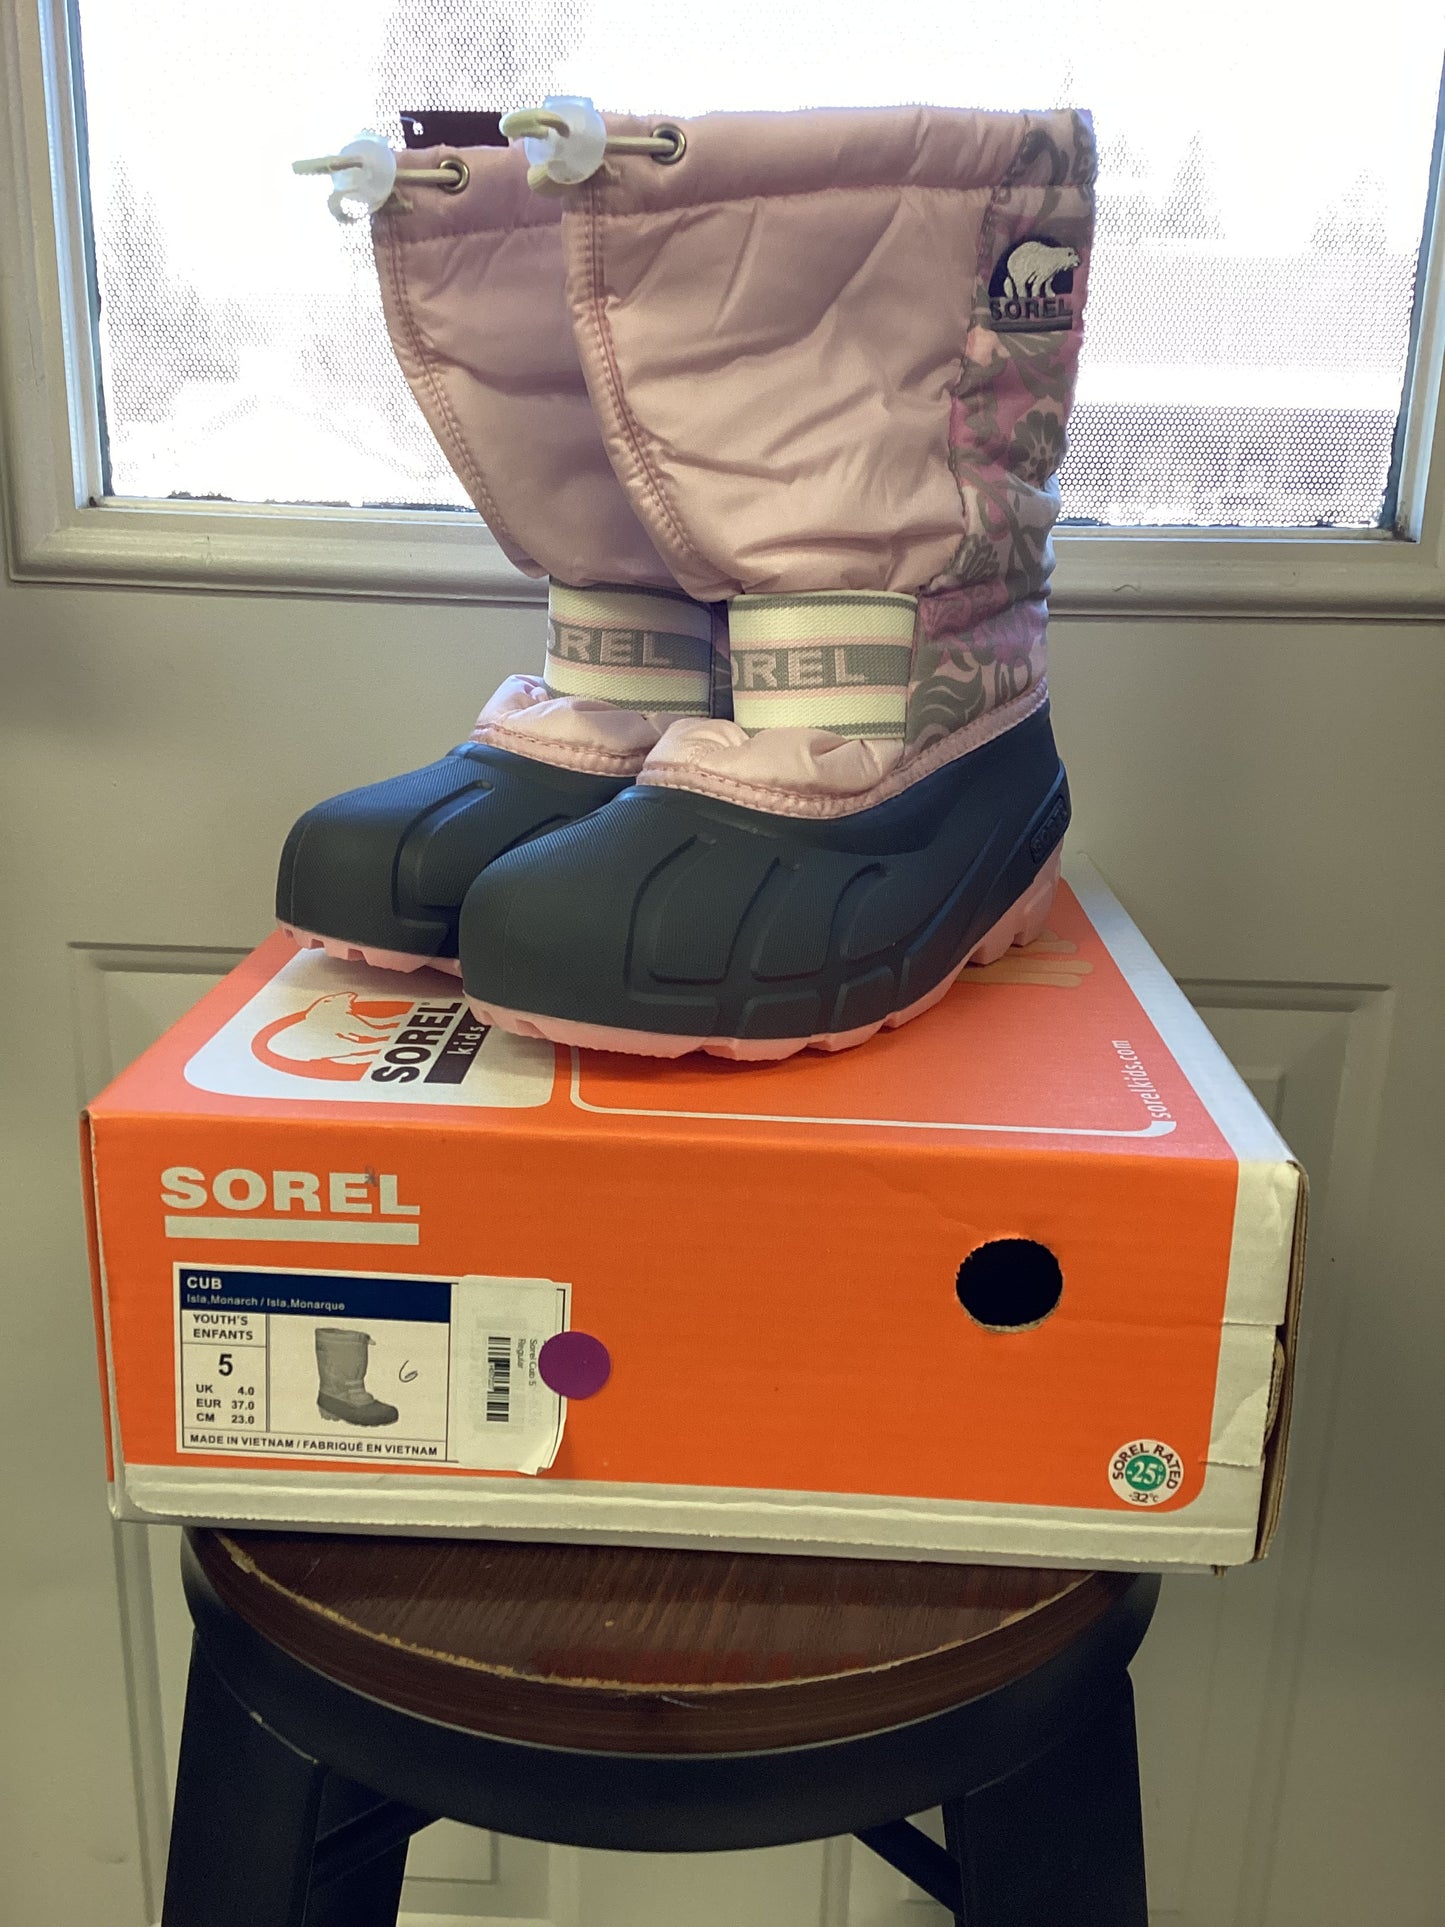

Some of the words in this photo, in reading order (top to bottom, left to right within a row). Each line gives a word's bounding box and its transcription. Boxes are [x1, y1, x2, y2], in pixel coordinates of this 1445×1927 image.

[989, 297, 1073, 320] SOREL
[371, 1002, 462, 1083] SOREL
[447, 1026, 485, 1055] kids
[1111, 1040, 1172, 1119] sorelkids.com
[160, 1166, 421, 1215] SOREL
[186, 1276, 222, 1290] CUB
[193, 1313, 248, 1326] YOUTH'S
[193, 1328, 253, 1340] ENFANTS
[218, 1353, 233, 1376] 5
[195, 1383, 214, 1394] UK
[237, 1386, 255, 1396] 4.0
[196, 1398, 222, 1409] EUR
[231, 1400, 255, 1411] 37.0
[196, 1412, 215, 1423] CM
[231, 1414, 255, 1425] 23.0
[190, 1434, 223, 1444] MADE
[226, 1435, 238, 1445] IN
[240, 1437, 294, 1449] VIETNAM
[303, 1440, 363, 1453] FABRIQUÉ
[366, 1443, 382, 1453] EN
[384, 1444, 438, 1456] VIETNAM
[1112, 1443, 1149, 1480] SOREL
[1153, 1444, 1181, 1489] RATED
